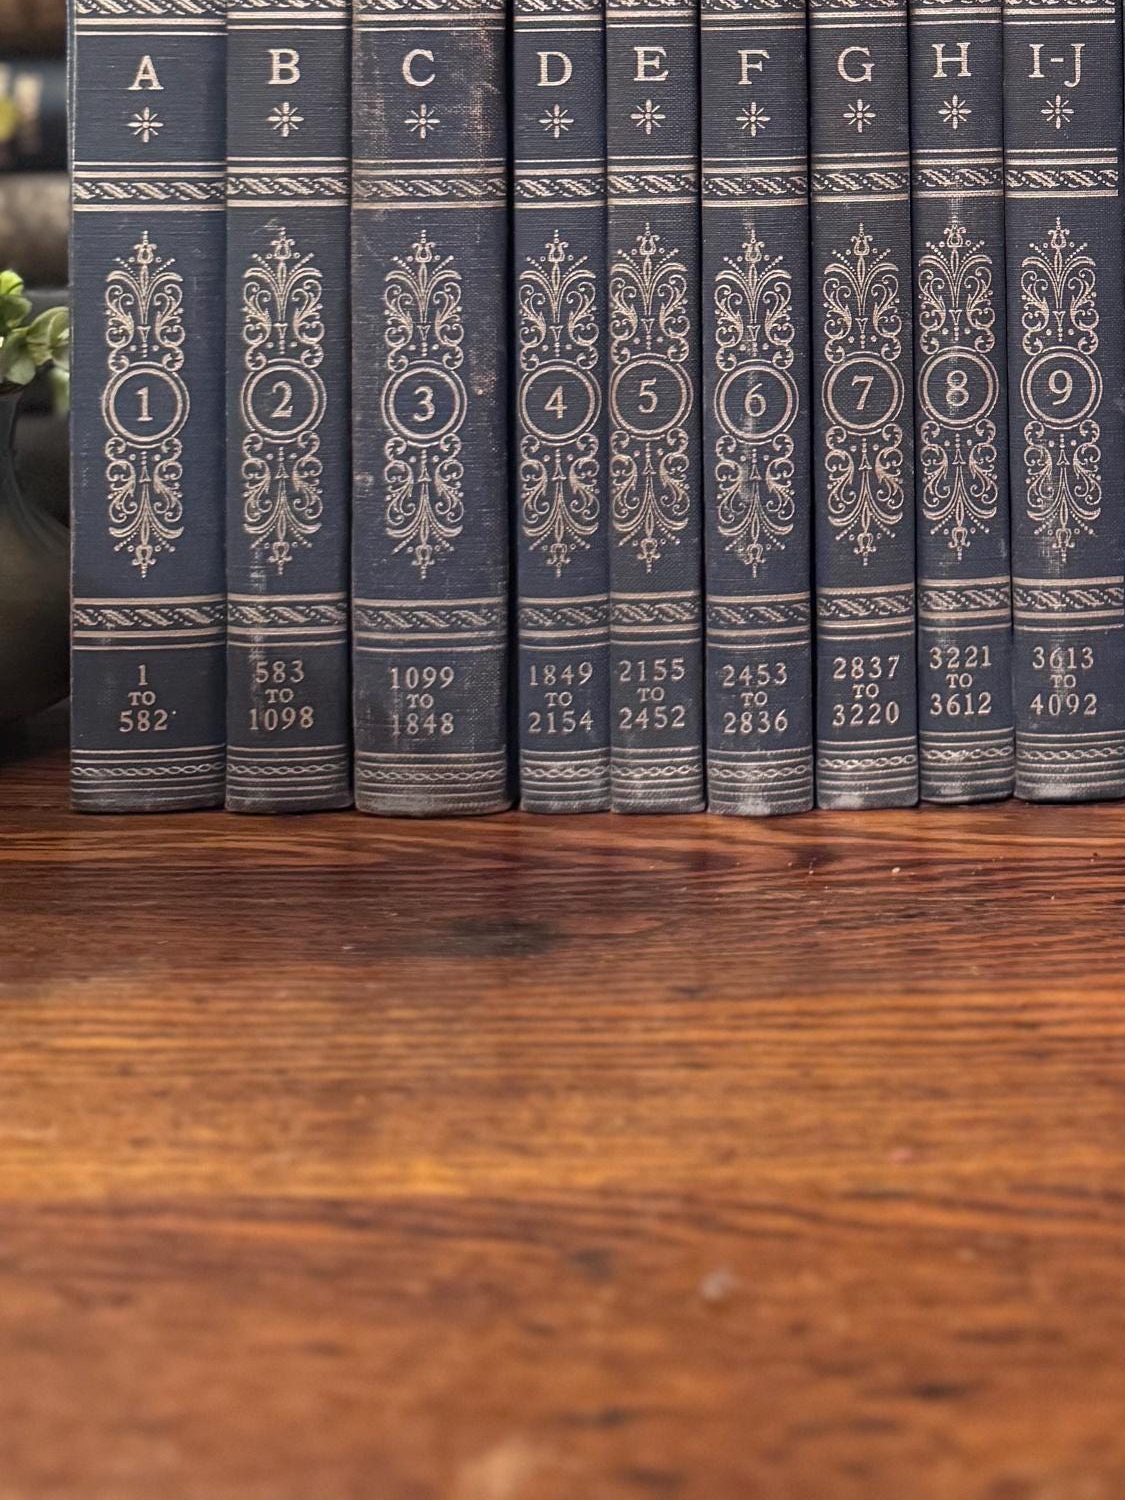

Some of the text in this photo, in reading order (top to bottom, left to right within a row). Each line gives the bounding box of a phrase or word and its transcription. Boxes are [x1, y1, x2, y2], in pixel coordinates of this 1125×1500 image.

[268, 49, 300, 84] B
[403, 49, 435, 86] C
[537, 52, 572, 86] D
[634, 47, 668, 81] E
[738, 50, 770, 84] F
[838, 47, 874, 82] G
[932, 42, 971, 77] H
[1029, 44, 1085, 87] I-J
[127, 56, 164, 90] A
[272, 381, 293, 417] 2
[639, 378, 657, 413] 5
[745, 383, 766, 416] 6
[852, 376, 873, 410] 7
[946, 370, 968, 406] 8
[1049, 370, 1072, 405] 9
[137, 387, 152, 421] 1
[414, 387, 434, 421] 3
[545, 386, 567, 418] 4
[620, 658, 684, 681] 2155
[834, 655, 899, 679] 2837
[930, 646, 991, 669] 3221
[1033, 647, 1093, 673] 3613
[139, 665, 147, 685] 1
[254, 660, 304, 683] 583
[391, 667, 453, 689] 1099
[530, 662, 592, 685] 1849
[723, 663, 787, 686] 2453
[946, 673, 972, 688] TO
[265, 689, 293, 703] TO
[407, 694, 433, 708] TO
[545, 692, 572, 706] TO
[741, 692, 767, 706] TO
[931, 692, 991, 715] 3612
[1031, 694, 1096, 716] 4092
[120, 710, 167, 732] 582
[250, 706, 313, 730] 1098
[393, 713, 453, 735] 1848
[529, 710, 593, 733] 2154
[620, 706, 685, 729] 2452
[725, 709, 787, 733] 2836
[833, 702, 899, 726] 3220
